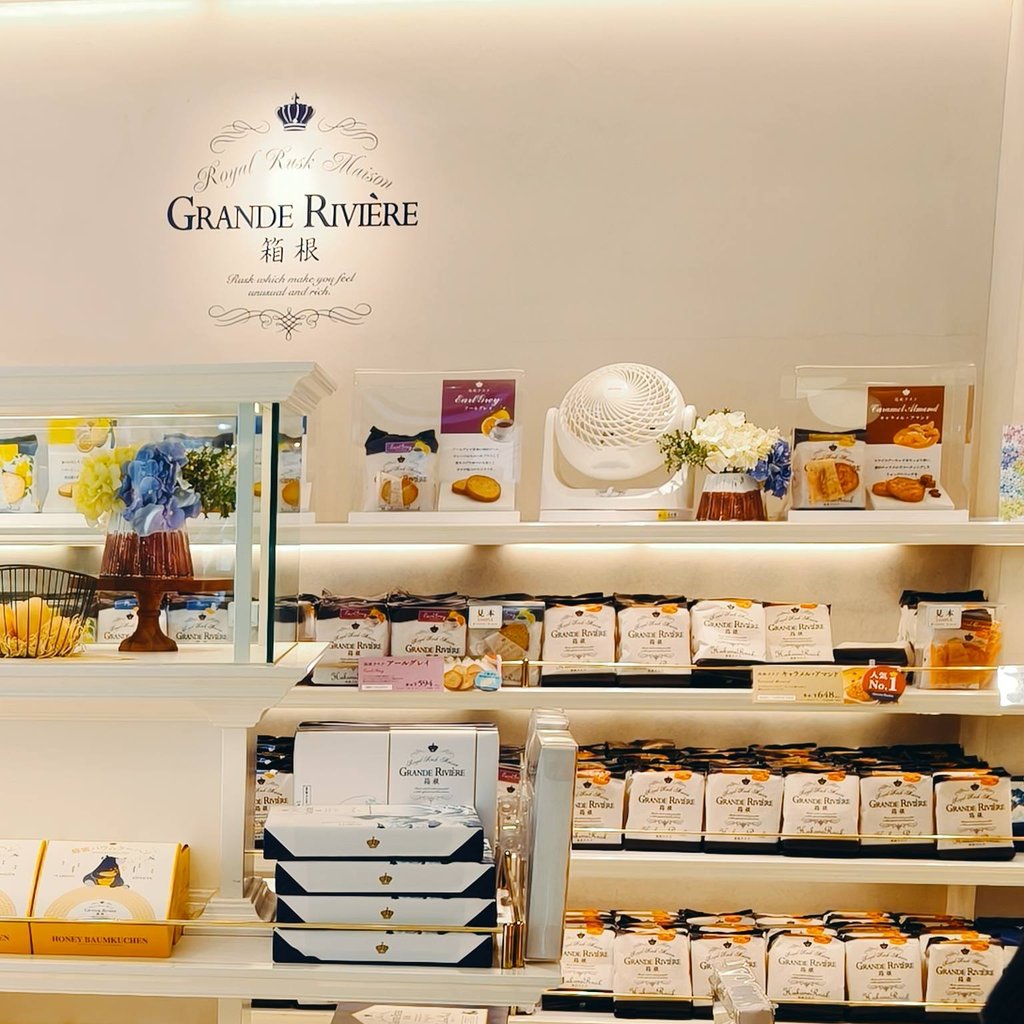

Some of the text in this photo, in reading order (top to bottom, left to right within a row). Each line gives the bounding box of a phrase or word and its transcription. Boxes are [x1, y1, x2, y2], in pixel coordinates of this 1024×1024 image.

[193, 145, 393, 193] Royal Rusk Maison
[166, 192, 419, 231] GRANDE RIVIÈRE
[260, 237, 320, 263] 箱根
[226, 271, 356, 288] Rusk which make you feel
[248, 286, 331, 297] unusual and rich.
[405, 645, 434, 654] GRANDE
[869, 671, 888, 680] 人気
[869, 676, 898, 692] No.1
[399, 767, 434, 778] GRANDE
[52, 935, 148, 944] HONEY BAUMKUCHEN
